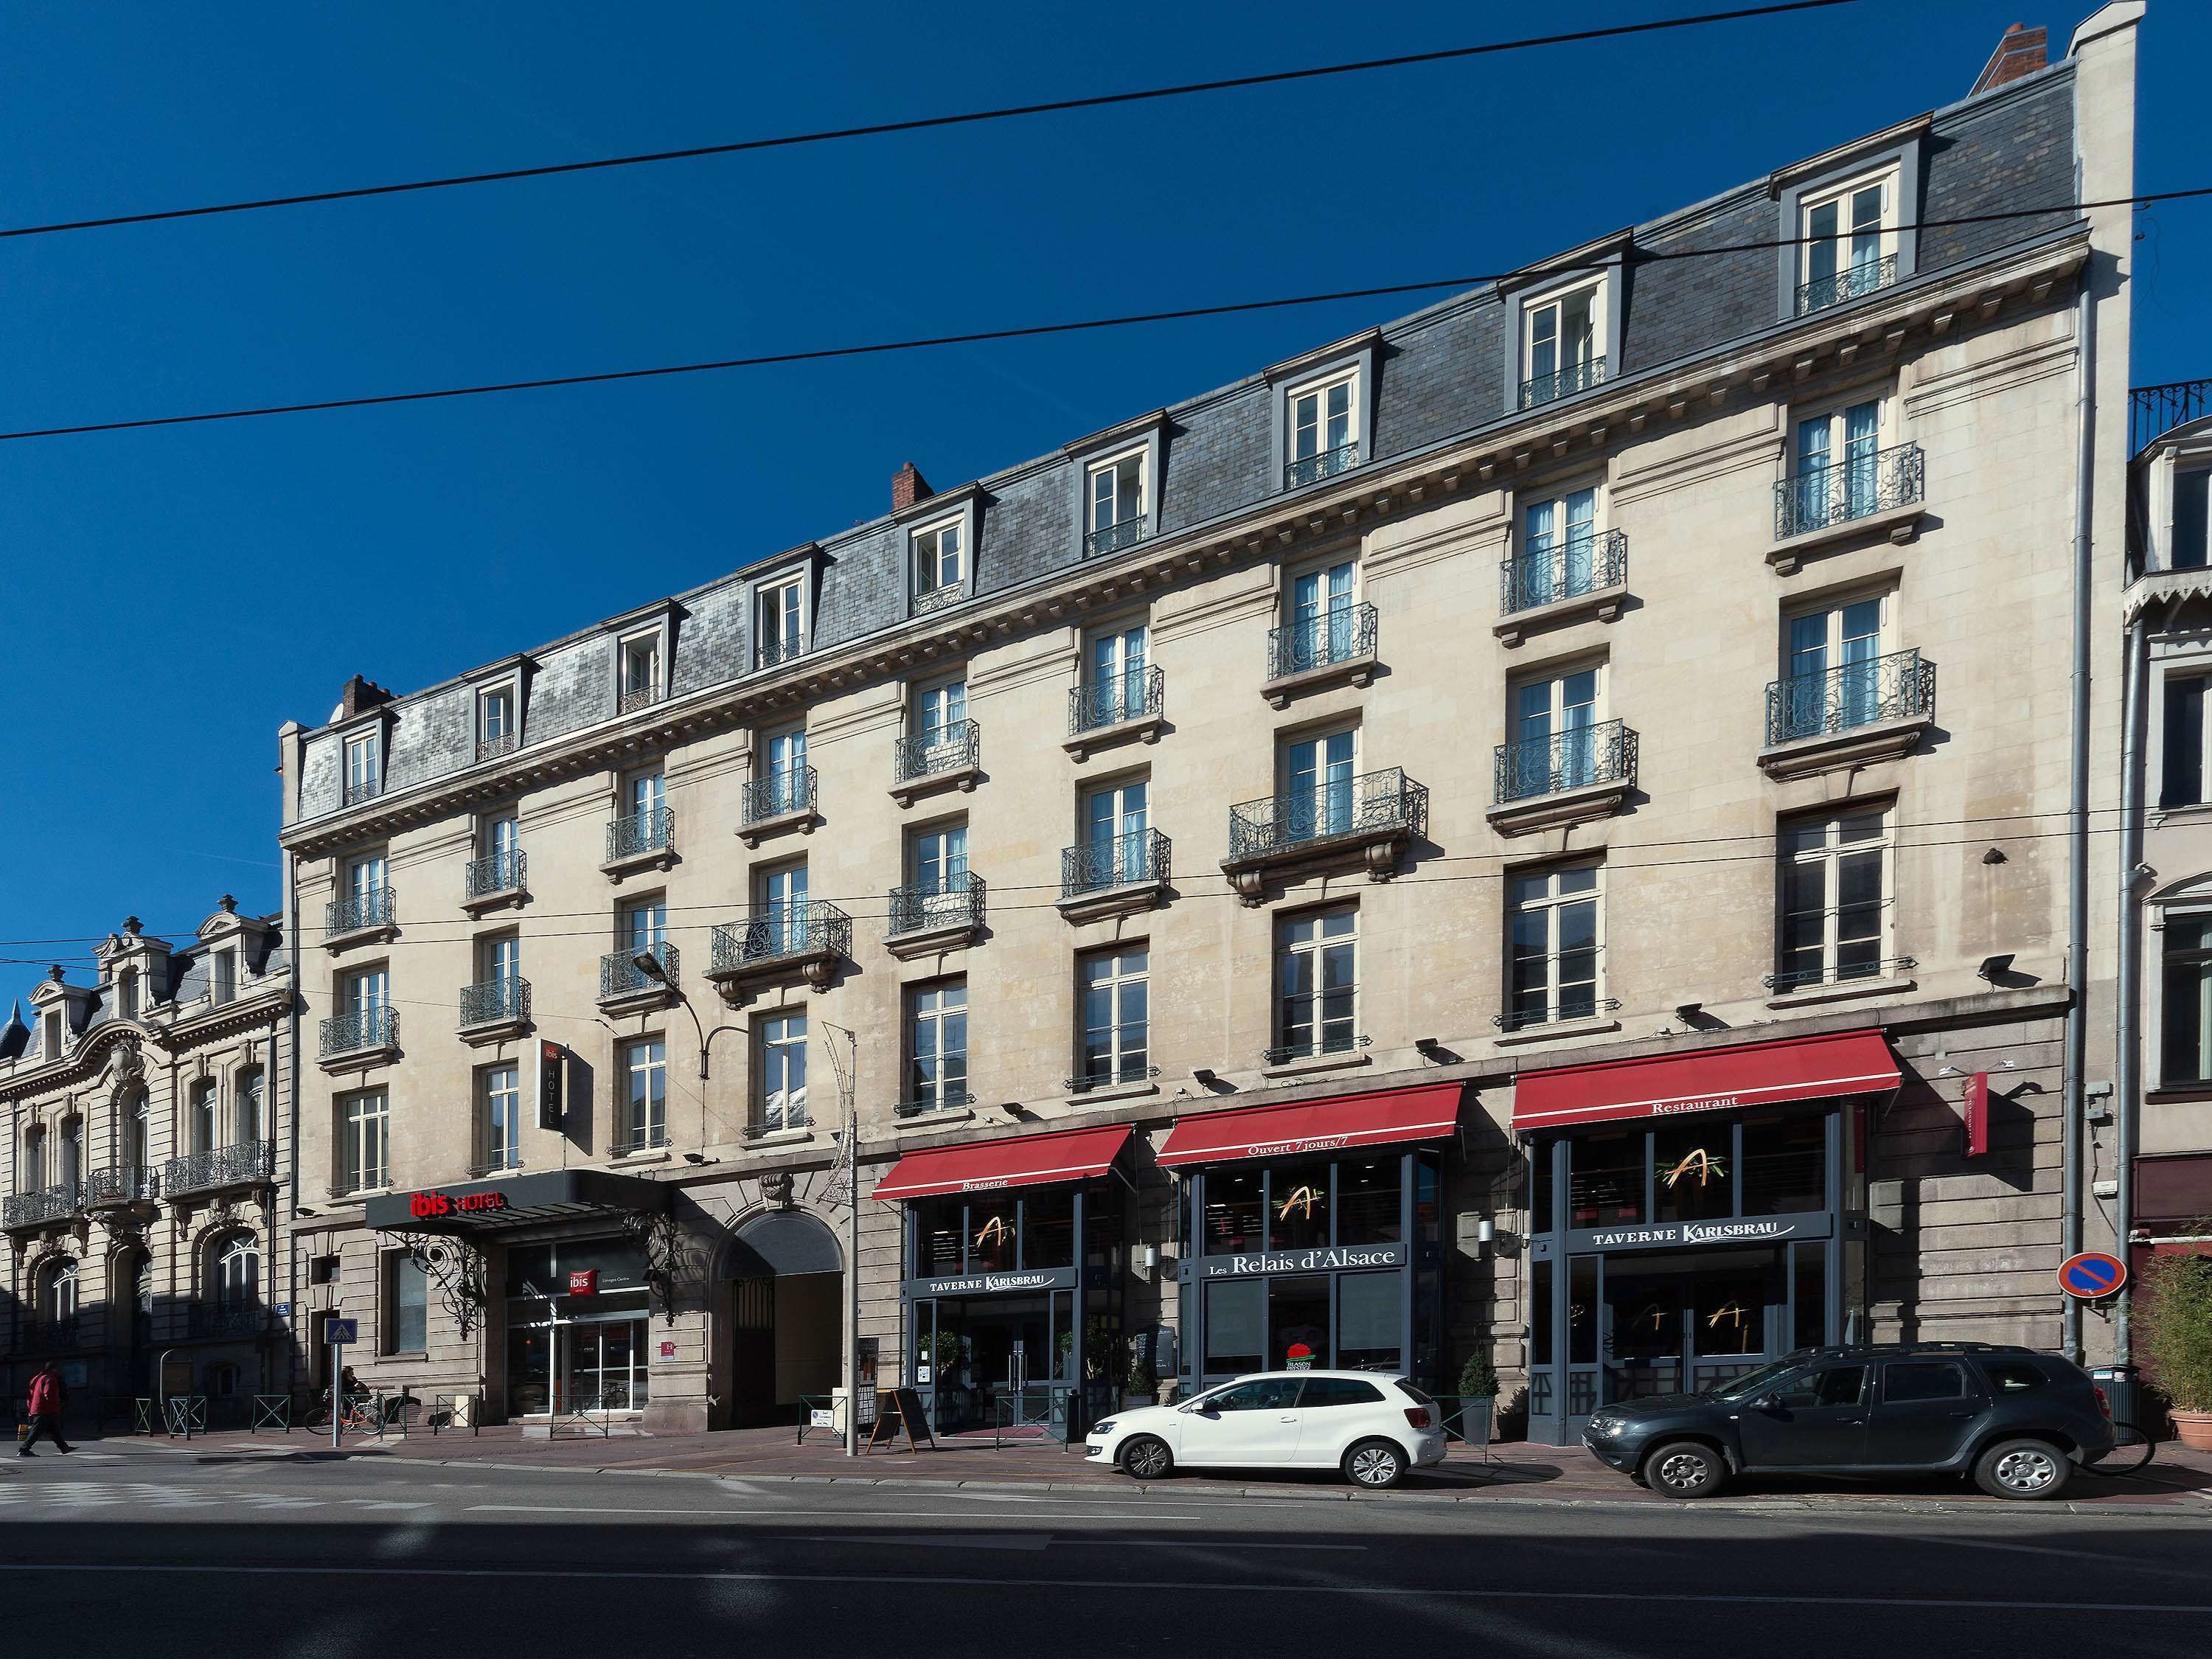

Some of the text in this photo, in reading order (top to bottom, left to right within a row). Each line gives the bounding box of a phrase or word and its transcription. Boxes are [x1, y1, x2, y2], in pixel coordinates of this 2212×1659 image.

[546, 1049, 557, 1059] ibis
[1652, 1096, 1739, 1114] Restaurant
[1248, 1144, 1290, 1155] Ouvert
[961, 1179, 1008, 1191] Brasserie
[411, 1192, 504, 1217] ibis HOTEL
[1593, 1222, 1779, 1245] TAVERNE KARLSBRAU
[1209, 1248, 1395, 1275] Les Relais d'Alsace
[570, 1276, 588, 1287] ibis
[930, 1276, 1046, 1291] TAVERNE KARLSBRAU
